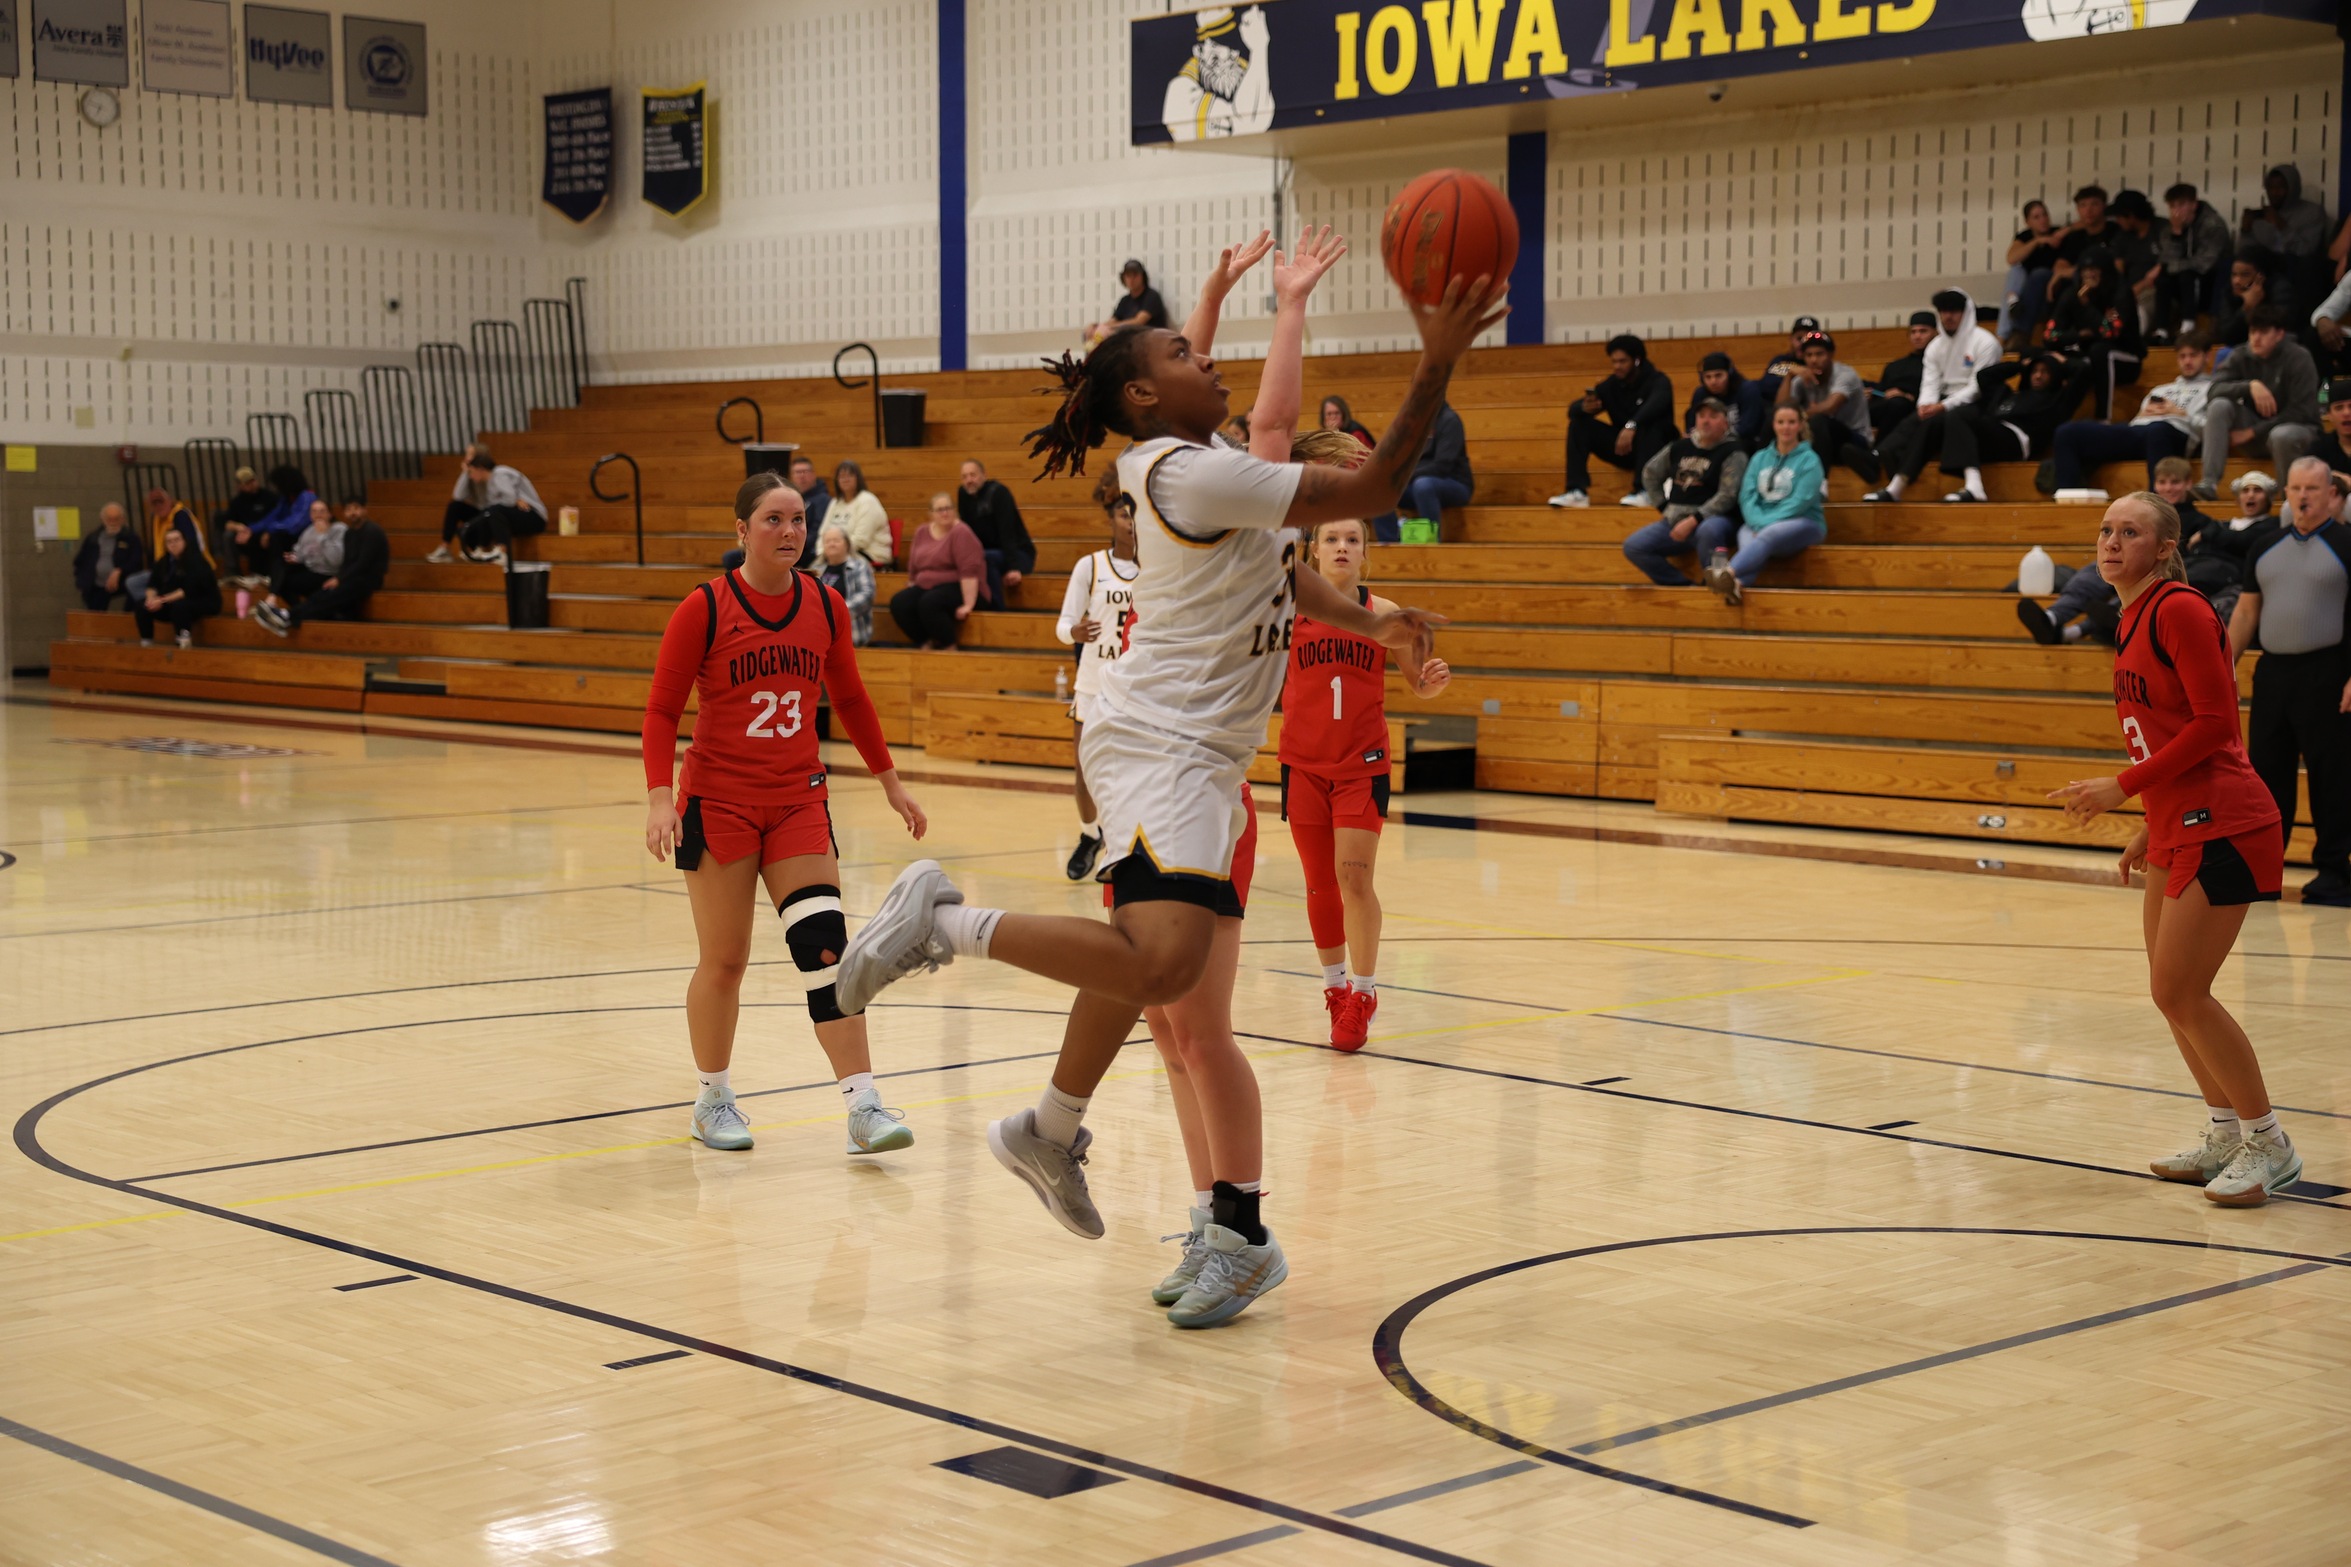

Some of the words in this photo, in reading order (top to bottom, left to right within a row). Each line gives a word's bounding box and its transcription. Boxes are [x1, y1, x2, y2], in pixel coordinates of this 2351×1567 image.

[37, 17, 103, 46] Avera
[1334, 0, 1569, 100] IOWA
[1106, 590, 1134, 605] IOW
[729, 643, 822, 688] RIDGEWATER
[1297, 637, 1376, 673] RIDGEWATER
[745, 690, 802, 738] 23
[1330, 675, 1342, 720] 1
